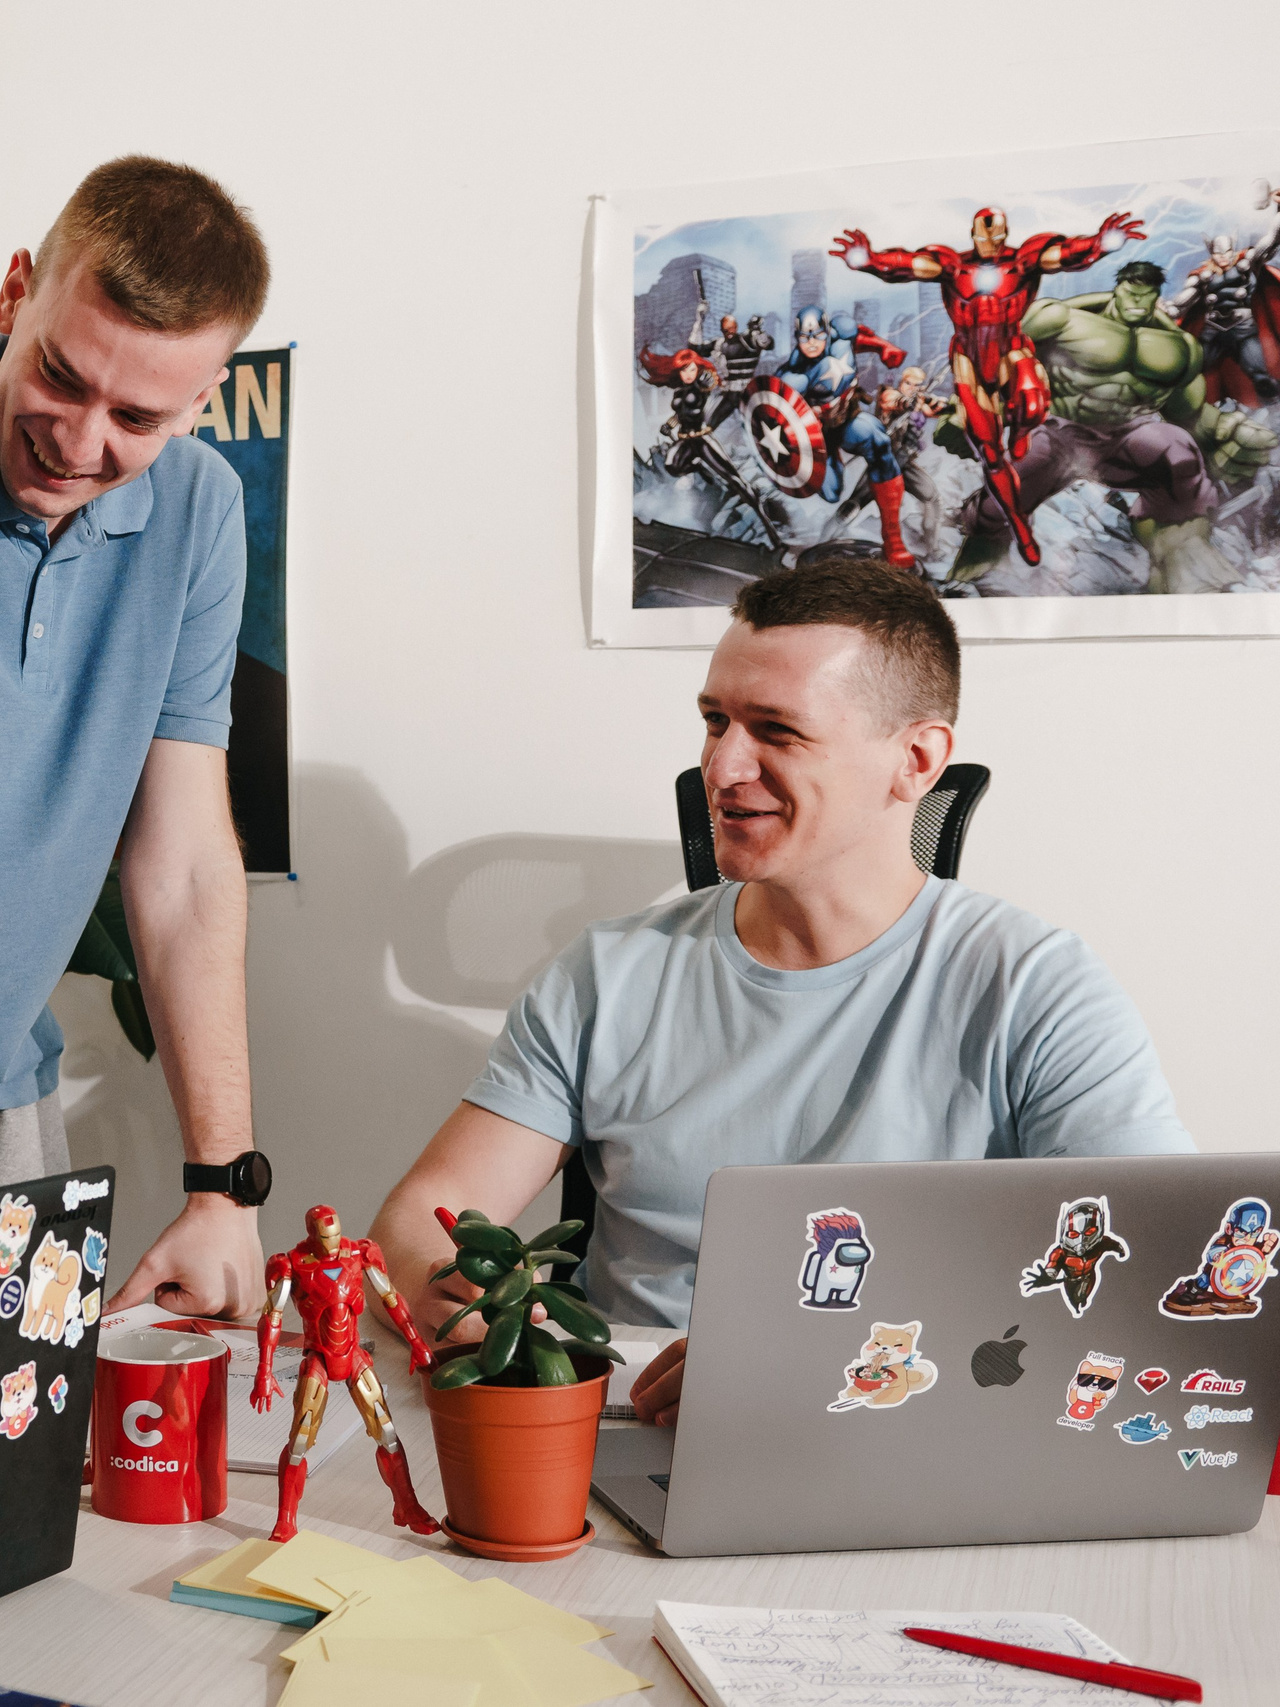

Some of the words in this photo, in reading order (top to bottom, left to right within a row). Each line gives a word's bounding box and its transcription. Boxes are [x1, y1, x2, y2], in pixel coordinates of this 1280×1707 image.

[1246, 1213, 1258, 1226] A
[1088, 1352, 1101, 1361] Full
[1102, 1355, 1124, 1365] snack
[1201, 1380, 1244, 1393] RAILS
[1211, 1408, 1252, 1421] React
[122, 1399, 164, 1448] C
[1058, 1417, 1094, 1429] developer
[1201, 1451, 1237, 1466] Vue.js
